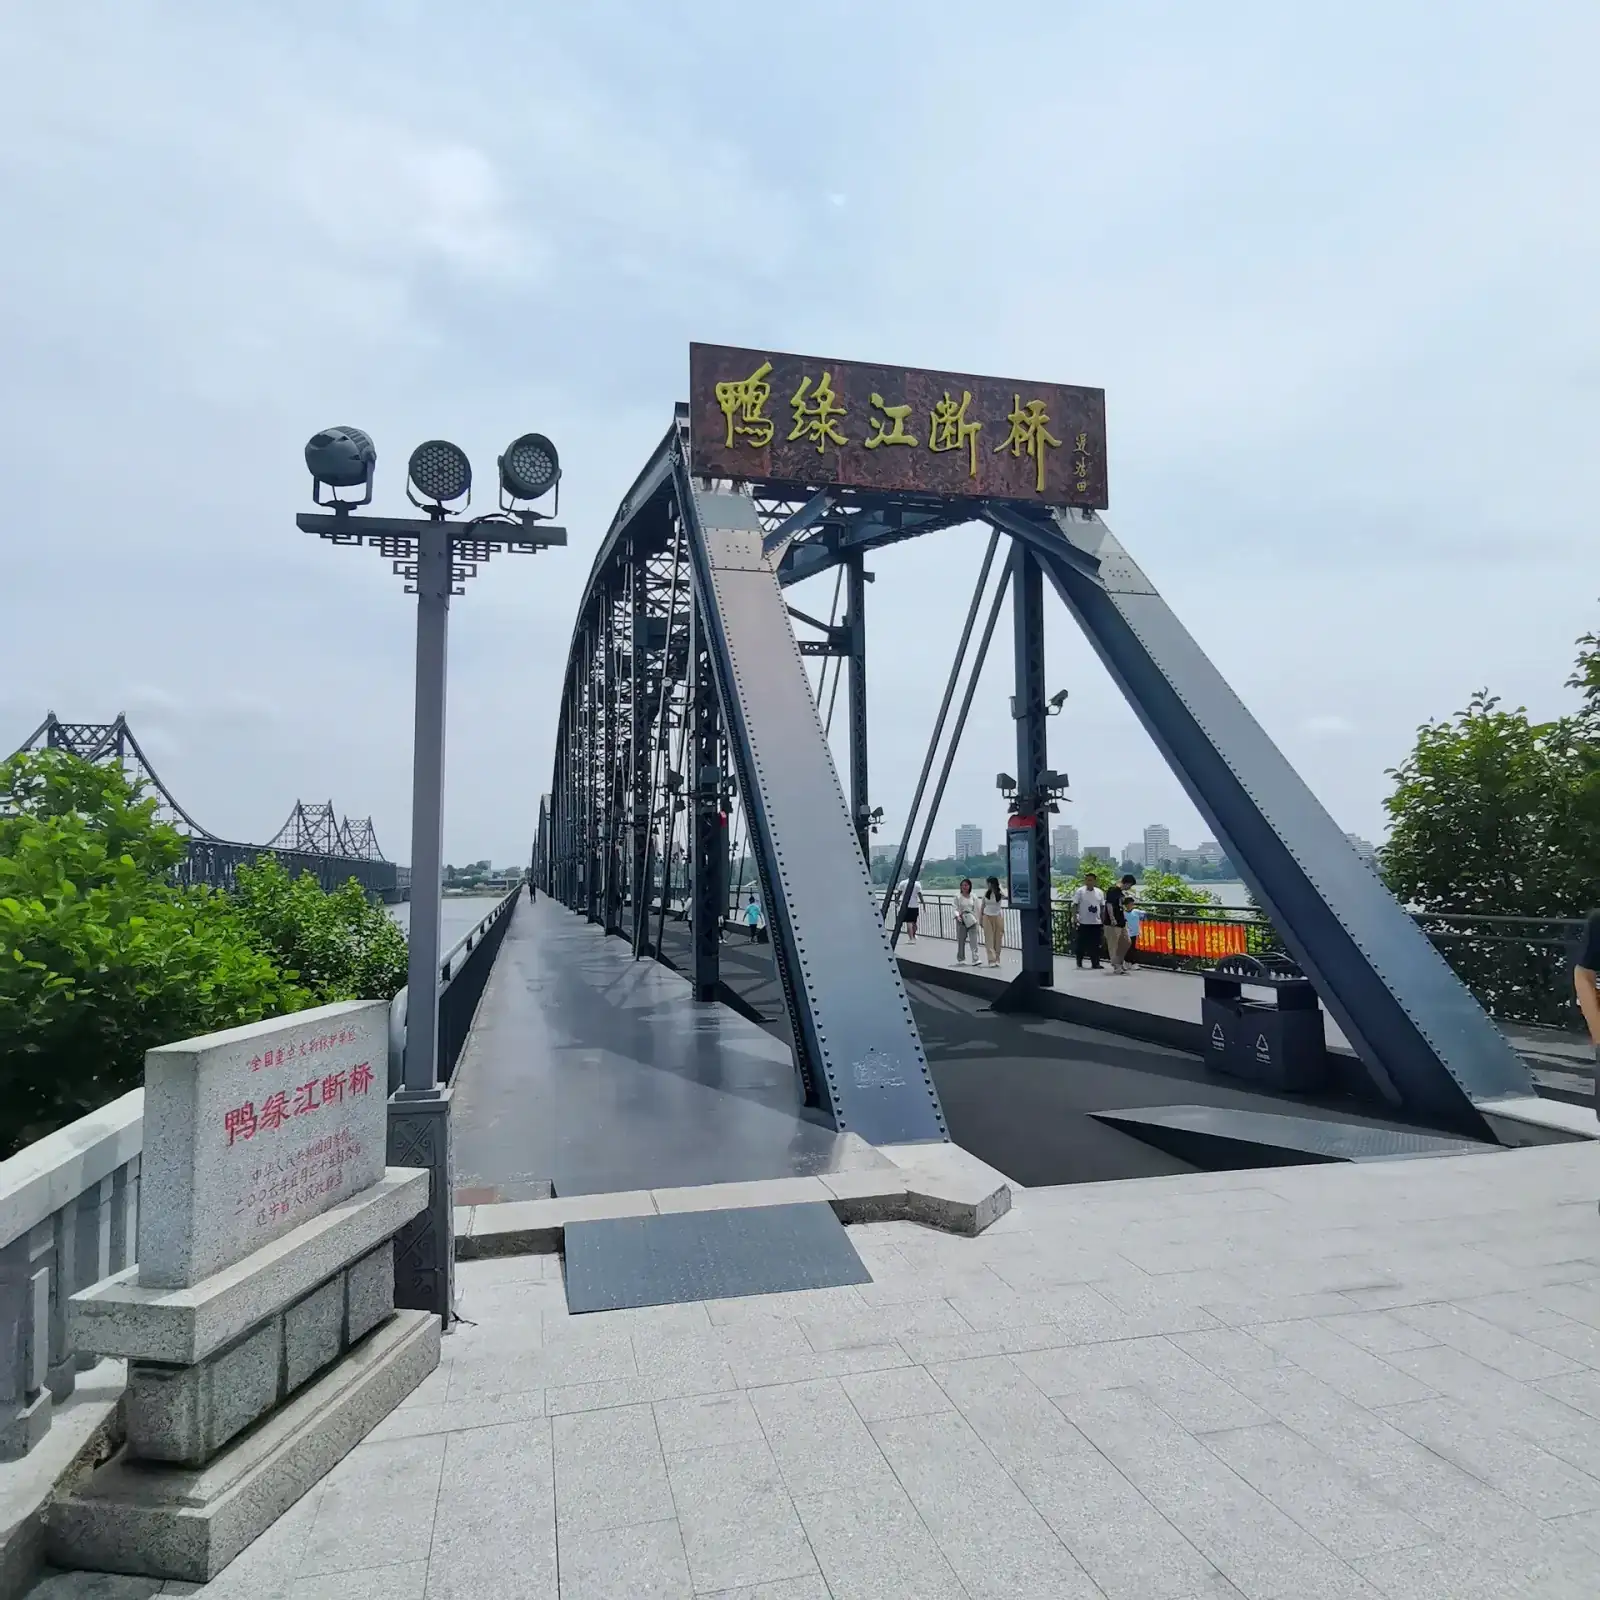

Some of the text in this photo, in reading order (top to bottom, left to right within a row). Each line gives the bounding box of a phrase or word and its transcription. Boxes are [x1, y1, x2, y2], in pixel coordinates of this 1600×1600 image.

[251, 1029, 357, 1072] 全国重点文物保护单位
[224, 1061, 375, 1147] 鸭绿江断桥
